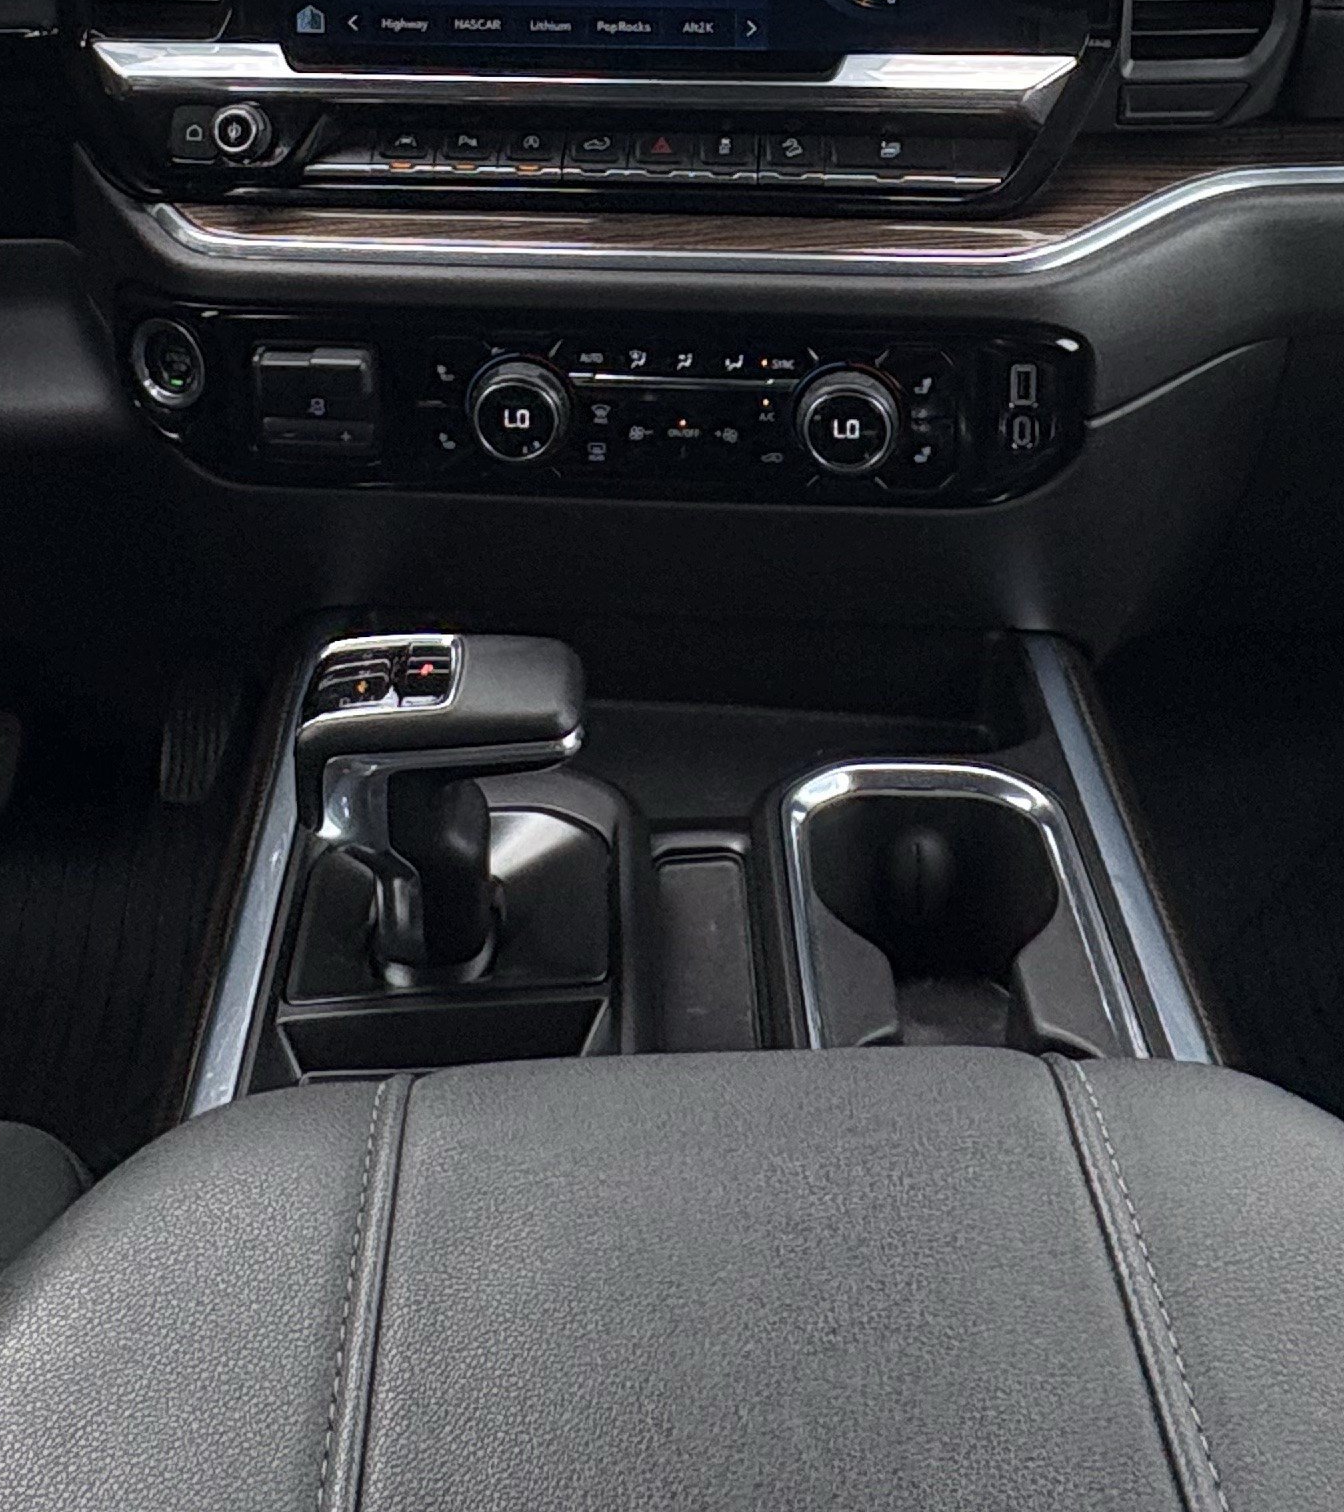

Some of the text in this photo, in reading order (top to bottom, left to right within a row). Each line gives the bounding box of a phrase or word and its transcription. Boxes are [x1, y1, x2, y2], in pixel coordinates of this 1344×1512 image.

[381, 17, 430, 33] Highway
[454, 18, 502, 31] NASCAR
[530, 19, 572, 32] Lithium
